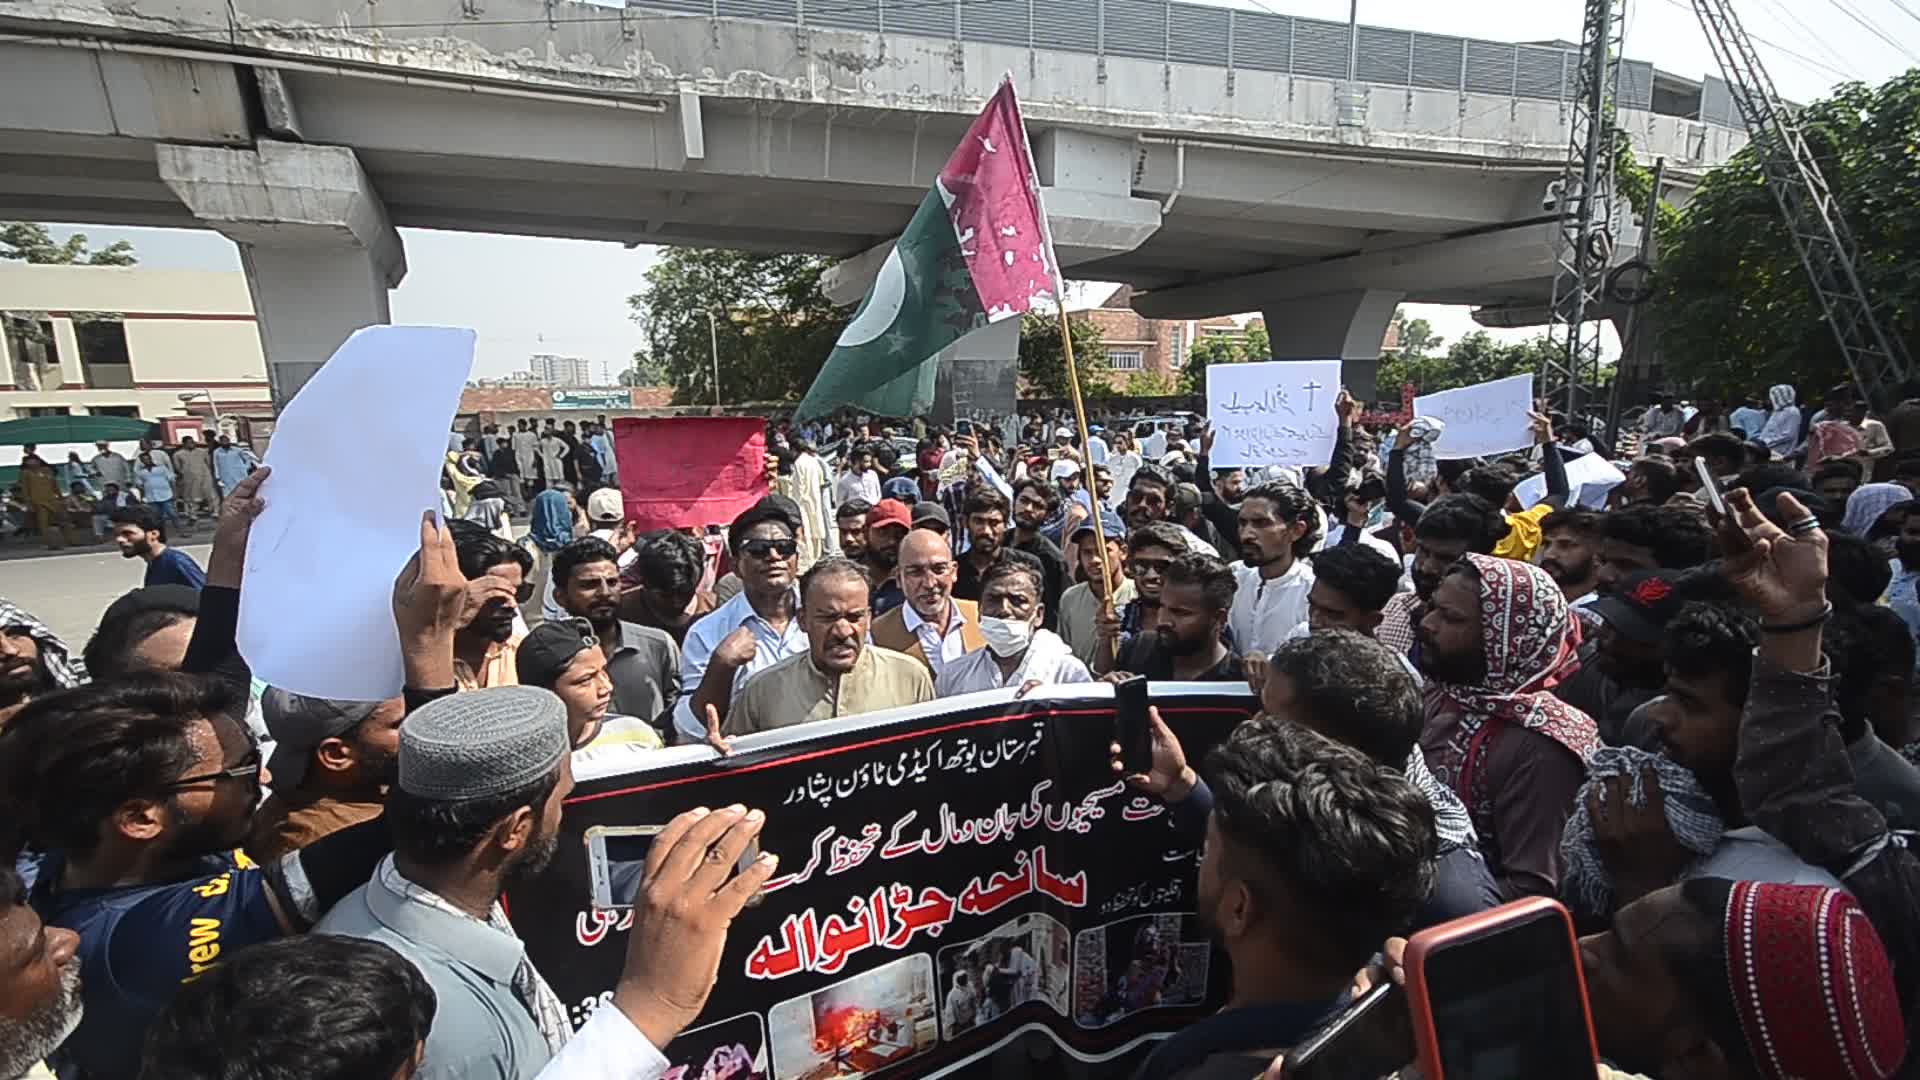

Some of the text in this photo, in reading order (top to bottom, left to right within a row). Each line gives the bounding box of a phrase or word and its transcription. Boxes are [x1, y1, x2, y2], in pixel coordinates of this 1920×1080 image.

[783, 722, 1044, 808] قبرستان یوتھ اکیڈمی ٹاؤن پشاور
[976, 804, 1018, 843] جان
[1021, 780, 1052, 829] کی
[1046, 779, 1125, 835] مسیحیوں
[826, 823, 881, 875] تحفظ
[881, 809, 922, 858] کے
[745, 846, 1087, 979] سانحہ جڑانوالہ
[1112, 887, 1136, 912] تحفظ
[1139, 879, 1184, 908] اقلیتوں
